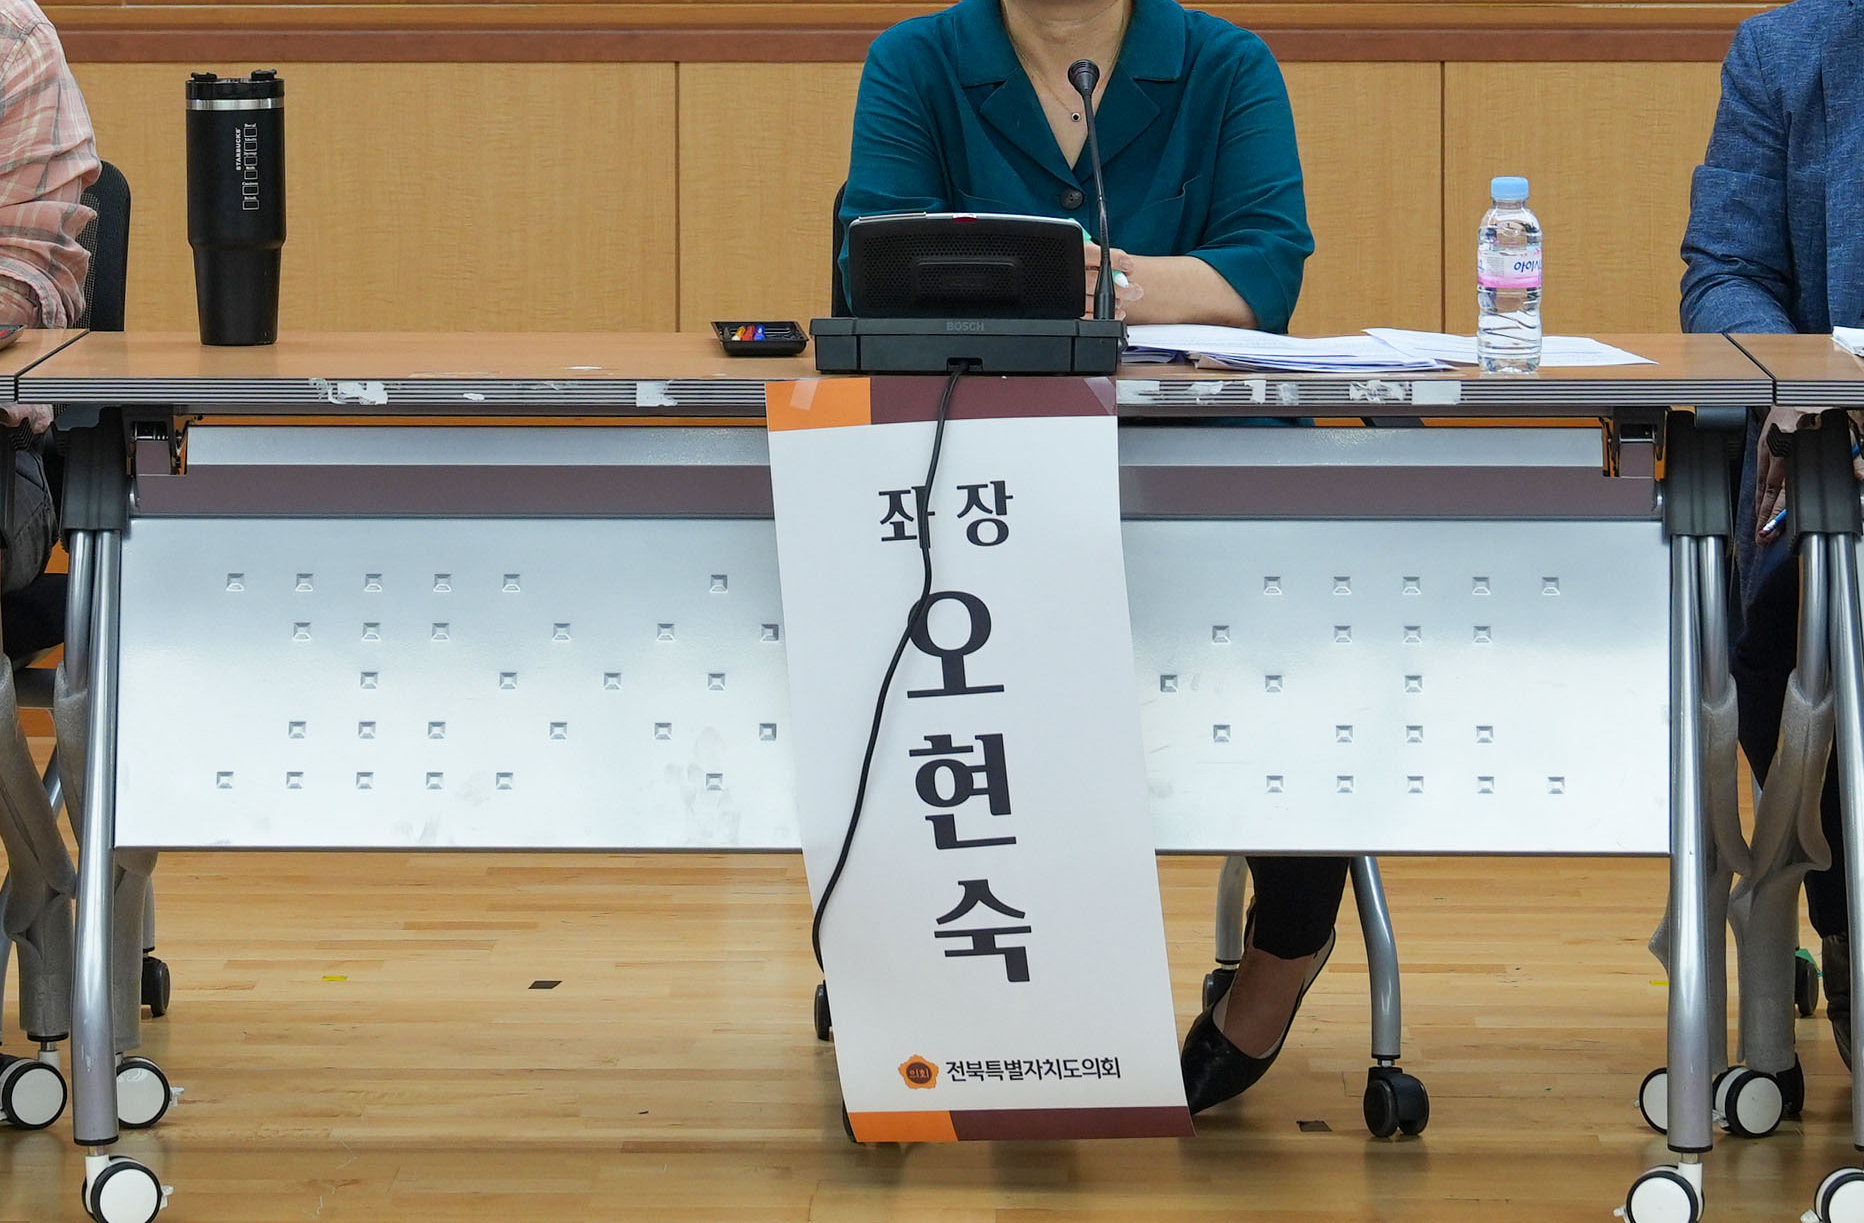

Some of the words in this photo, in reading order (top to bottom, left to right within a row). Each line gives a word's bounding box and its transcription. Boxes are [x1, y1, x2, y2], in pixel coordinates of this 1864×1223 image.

[946, 321, 984, 331] BOSCH
[906, 590, 1032, 983] 오현숙
[945, 1057, 1121, 1082] 전북특별자치도의회
